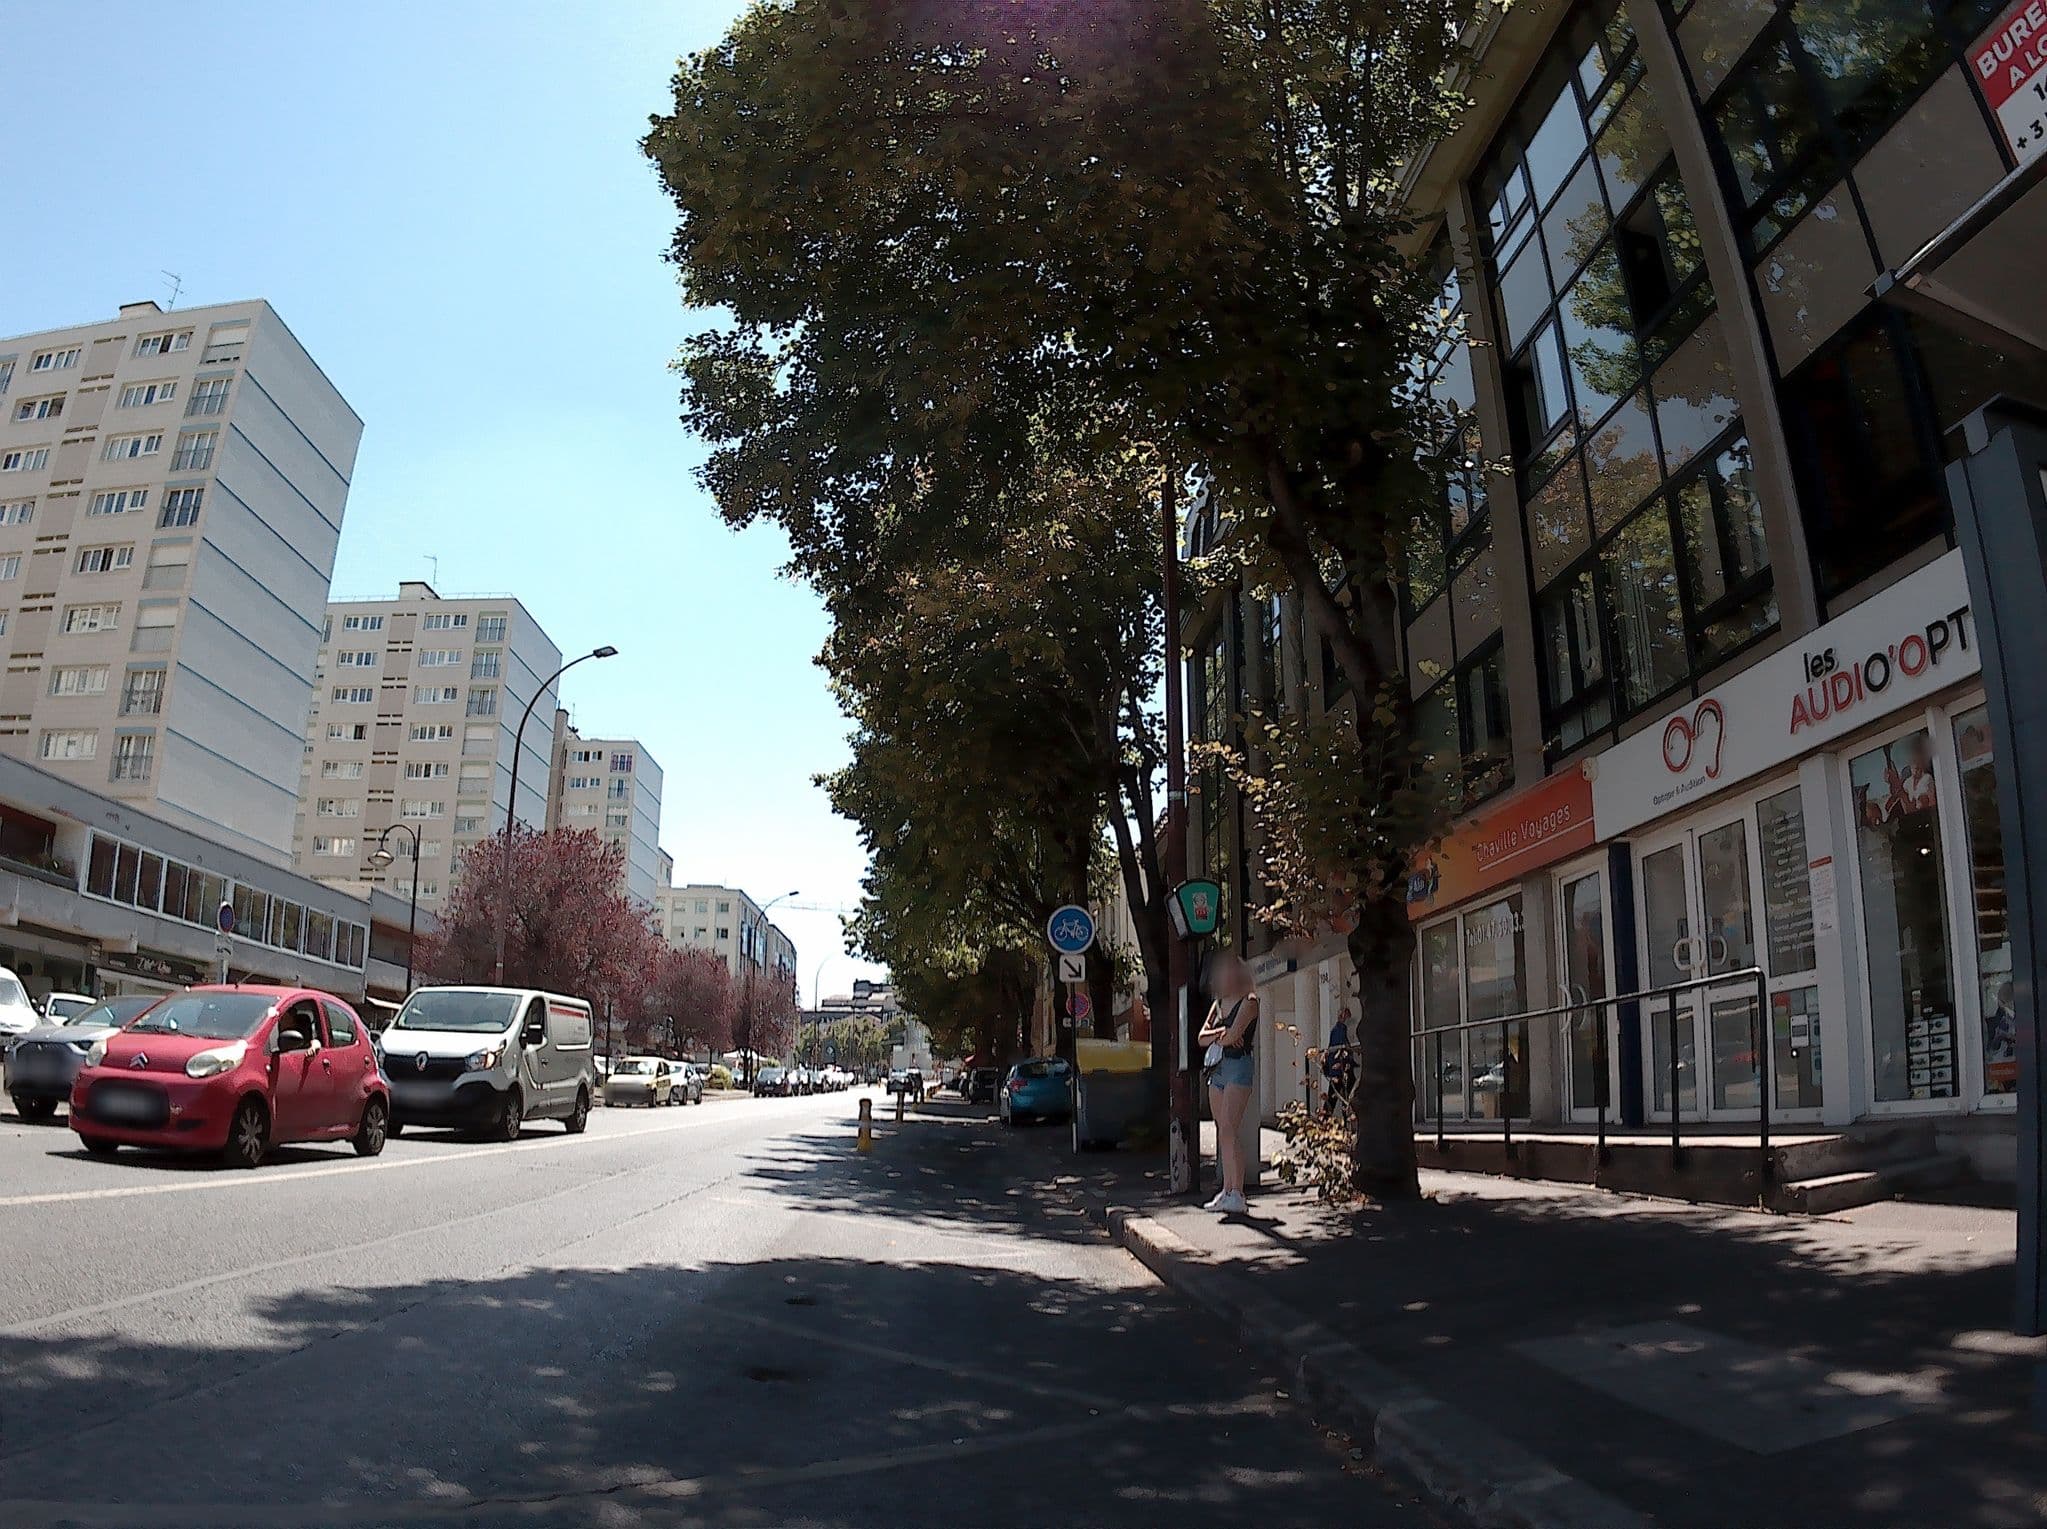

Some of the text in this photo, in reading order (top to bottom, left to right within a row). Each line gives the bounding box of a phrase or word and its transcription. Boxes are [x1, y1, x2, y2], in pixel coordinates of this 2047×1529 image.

[1976, 0, 2047, 80] BURE
[2008, 64, 2027, 88] A
[1803, 645, 1837, 683] les
[1476, 803, 1571, 863] Chaville Voyages
